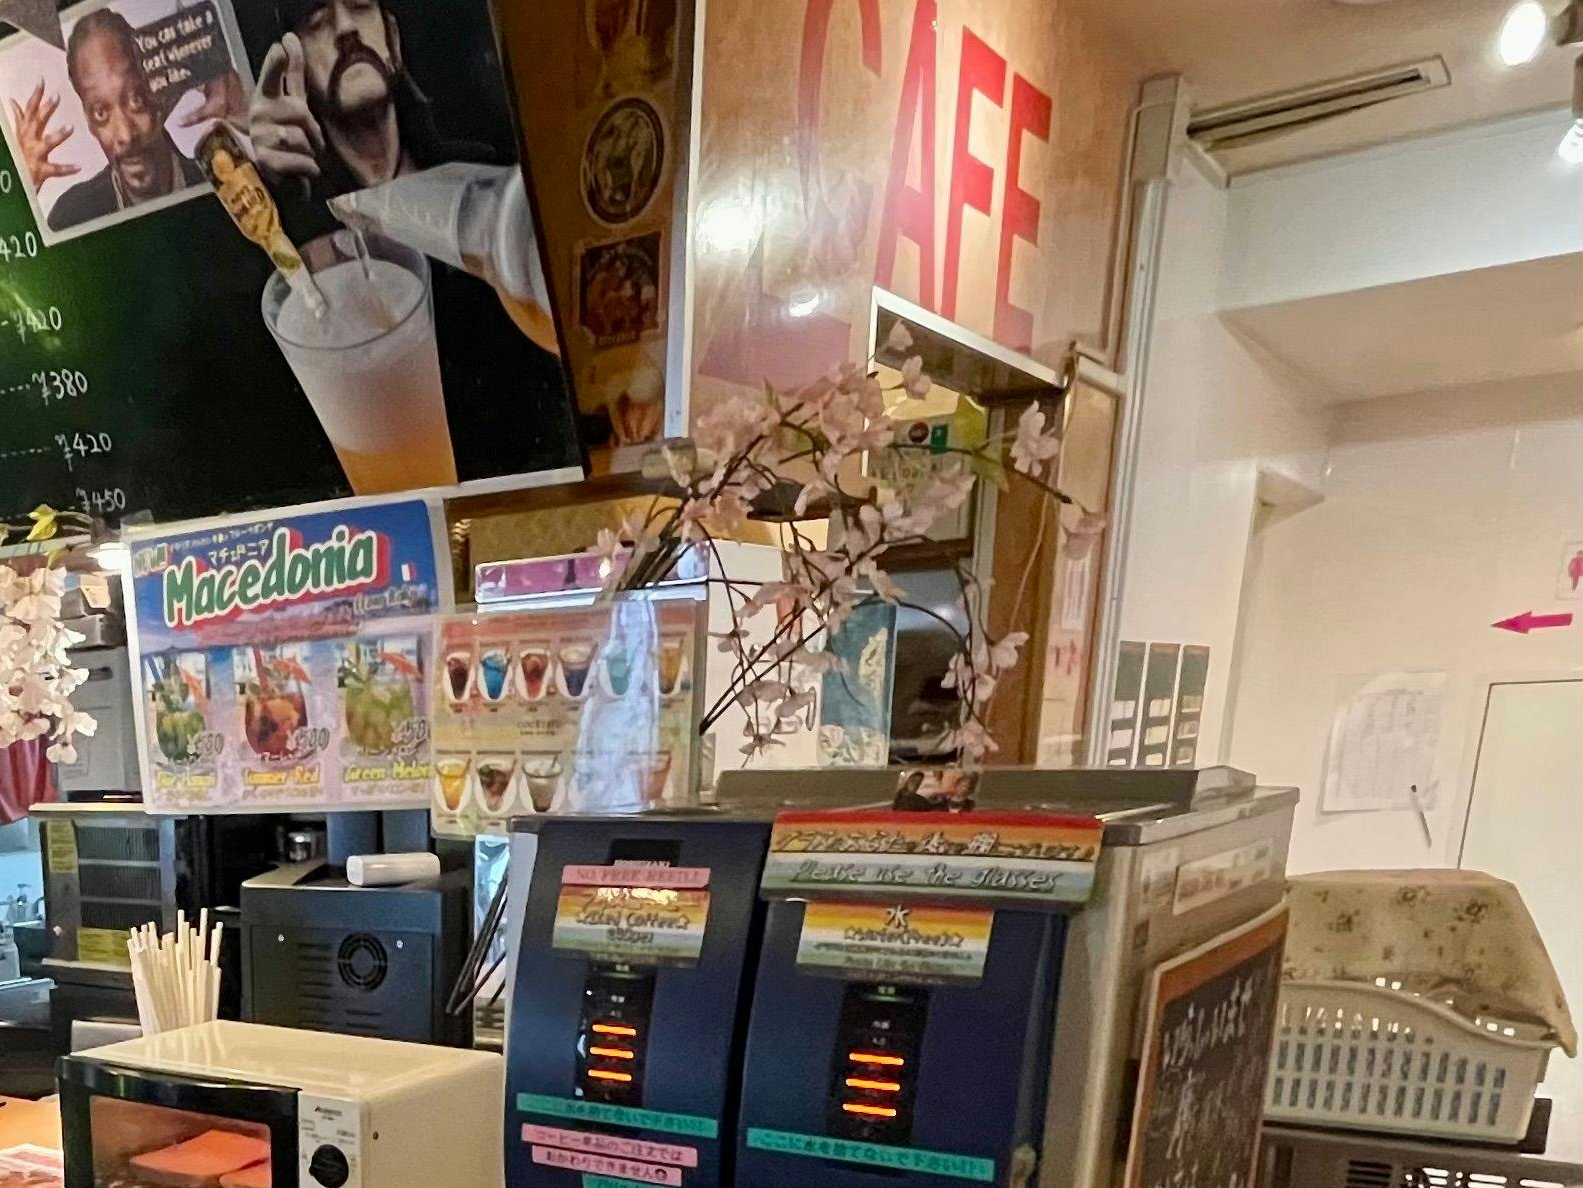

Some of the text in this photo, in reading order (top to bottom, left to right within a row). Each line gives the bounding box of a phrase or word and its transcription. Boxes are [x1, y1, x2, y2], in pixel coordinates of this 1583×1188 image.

[135, 36, 159, 53] You
[158, 27, 176, 44] can
[177, 15, 203, 35] take
[797, 0, 1053, 354] CAFE
[163, 525, 379, 628] Macedonia
[874, 864, 914, 884] use
[924, 861, 962, 886] the
[971, 865, 1064, 893] glasses
[884, 904, 910, 928] 水
